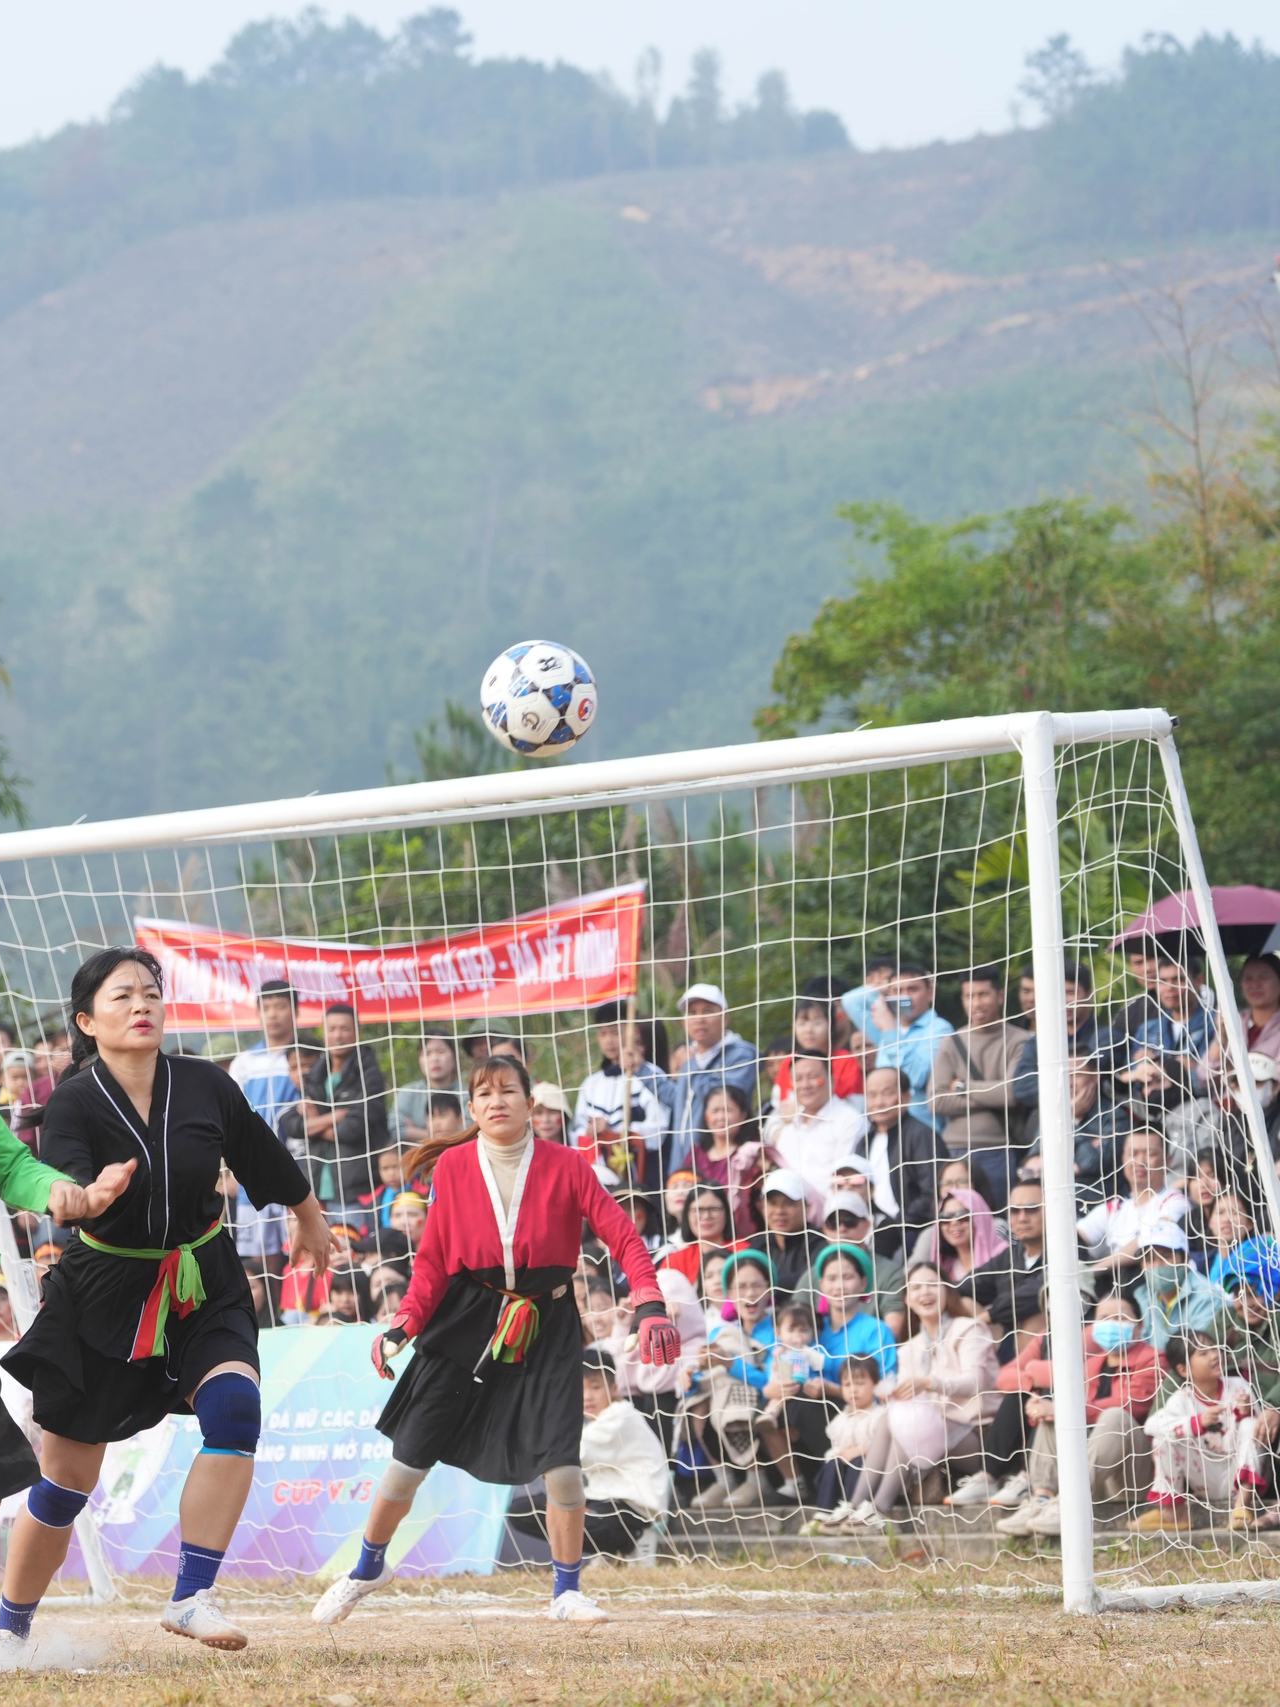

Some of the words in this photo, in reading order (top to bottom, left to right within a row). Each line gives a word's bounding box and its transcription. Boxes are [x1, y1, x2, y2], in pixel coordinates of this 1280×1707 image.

[535, 922, 572, 984] HẾT
[321, 1408, 356, 1429] CÁC
[359, 1405, 381, 1427] DÂ
[254, 1440, 287, 1463] ẢNG
[290, 1444, 329, 1463] NINH
[332, 1439, 359, 1461] MỞ
[361, 1439, 394, 1463] RỘN
[273, 1480, 323, 1506] CUP
[326, 1481, 374, 1504] VTV5
